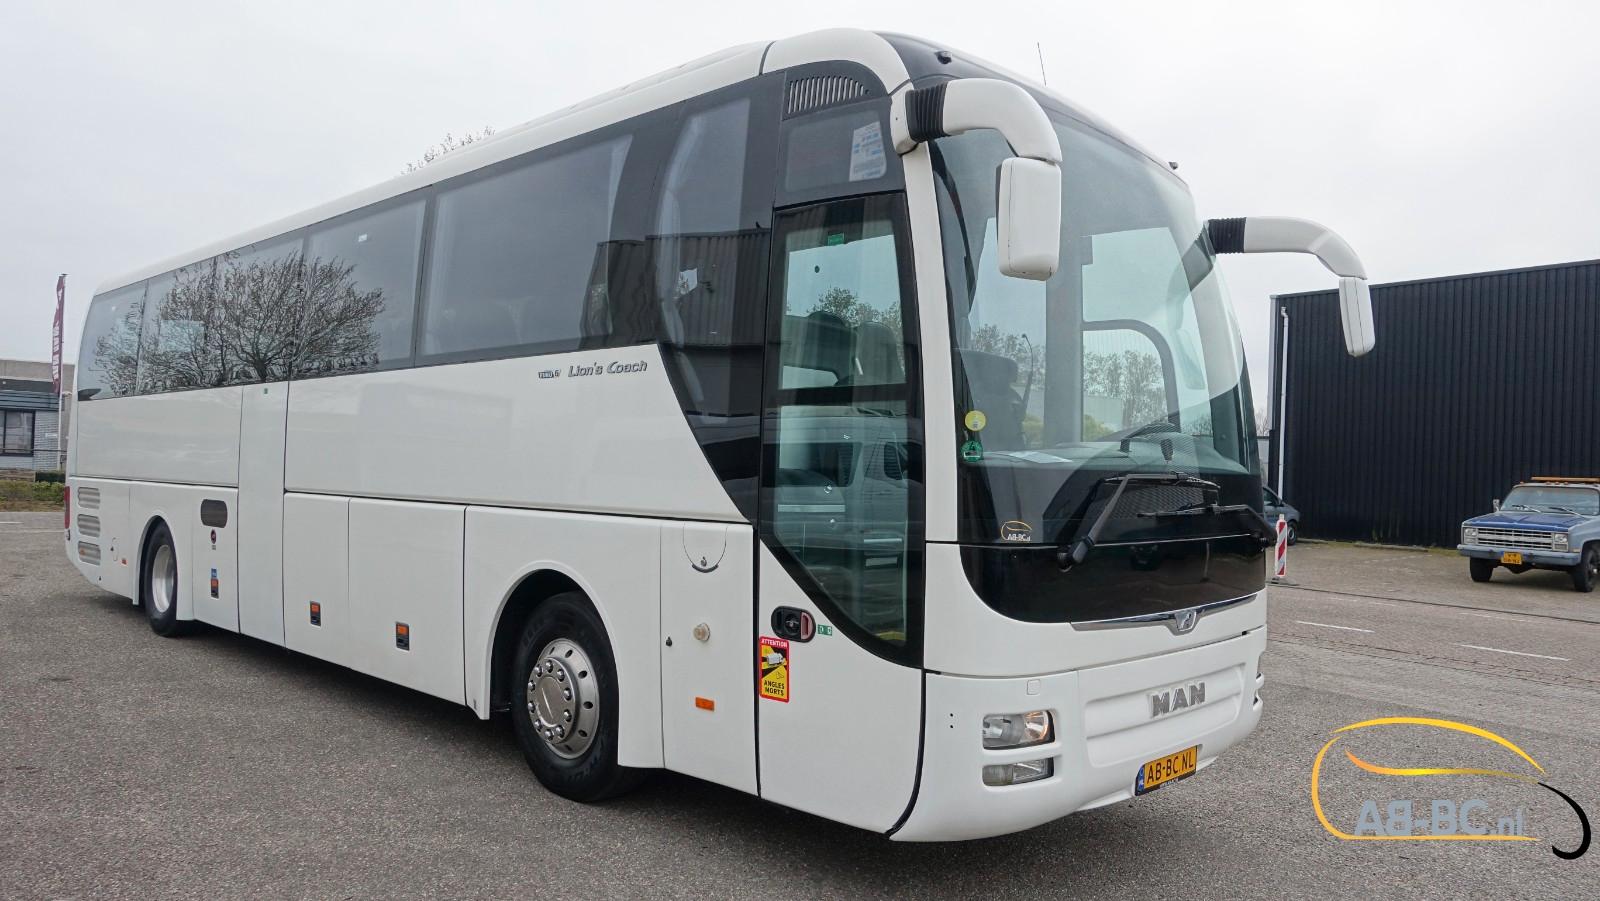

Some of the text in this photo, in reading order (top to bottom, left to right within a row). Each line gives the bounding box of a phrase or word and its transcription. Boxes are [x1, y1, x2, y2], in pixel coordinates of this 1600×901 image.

[568, 362, 603, 377] Lion's
[607, 360, 648, 374] Coach
[761, 638, 788, 648] ATTENTION
[763, 680, 785, 690] ANGLES
[764, 687, 785, 697] MORTS
[1150, 682, 1206, 718] MAN
[1146, 751, 1194, 784] AB-BC.NL
